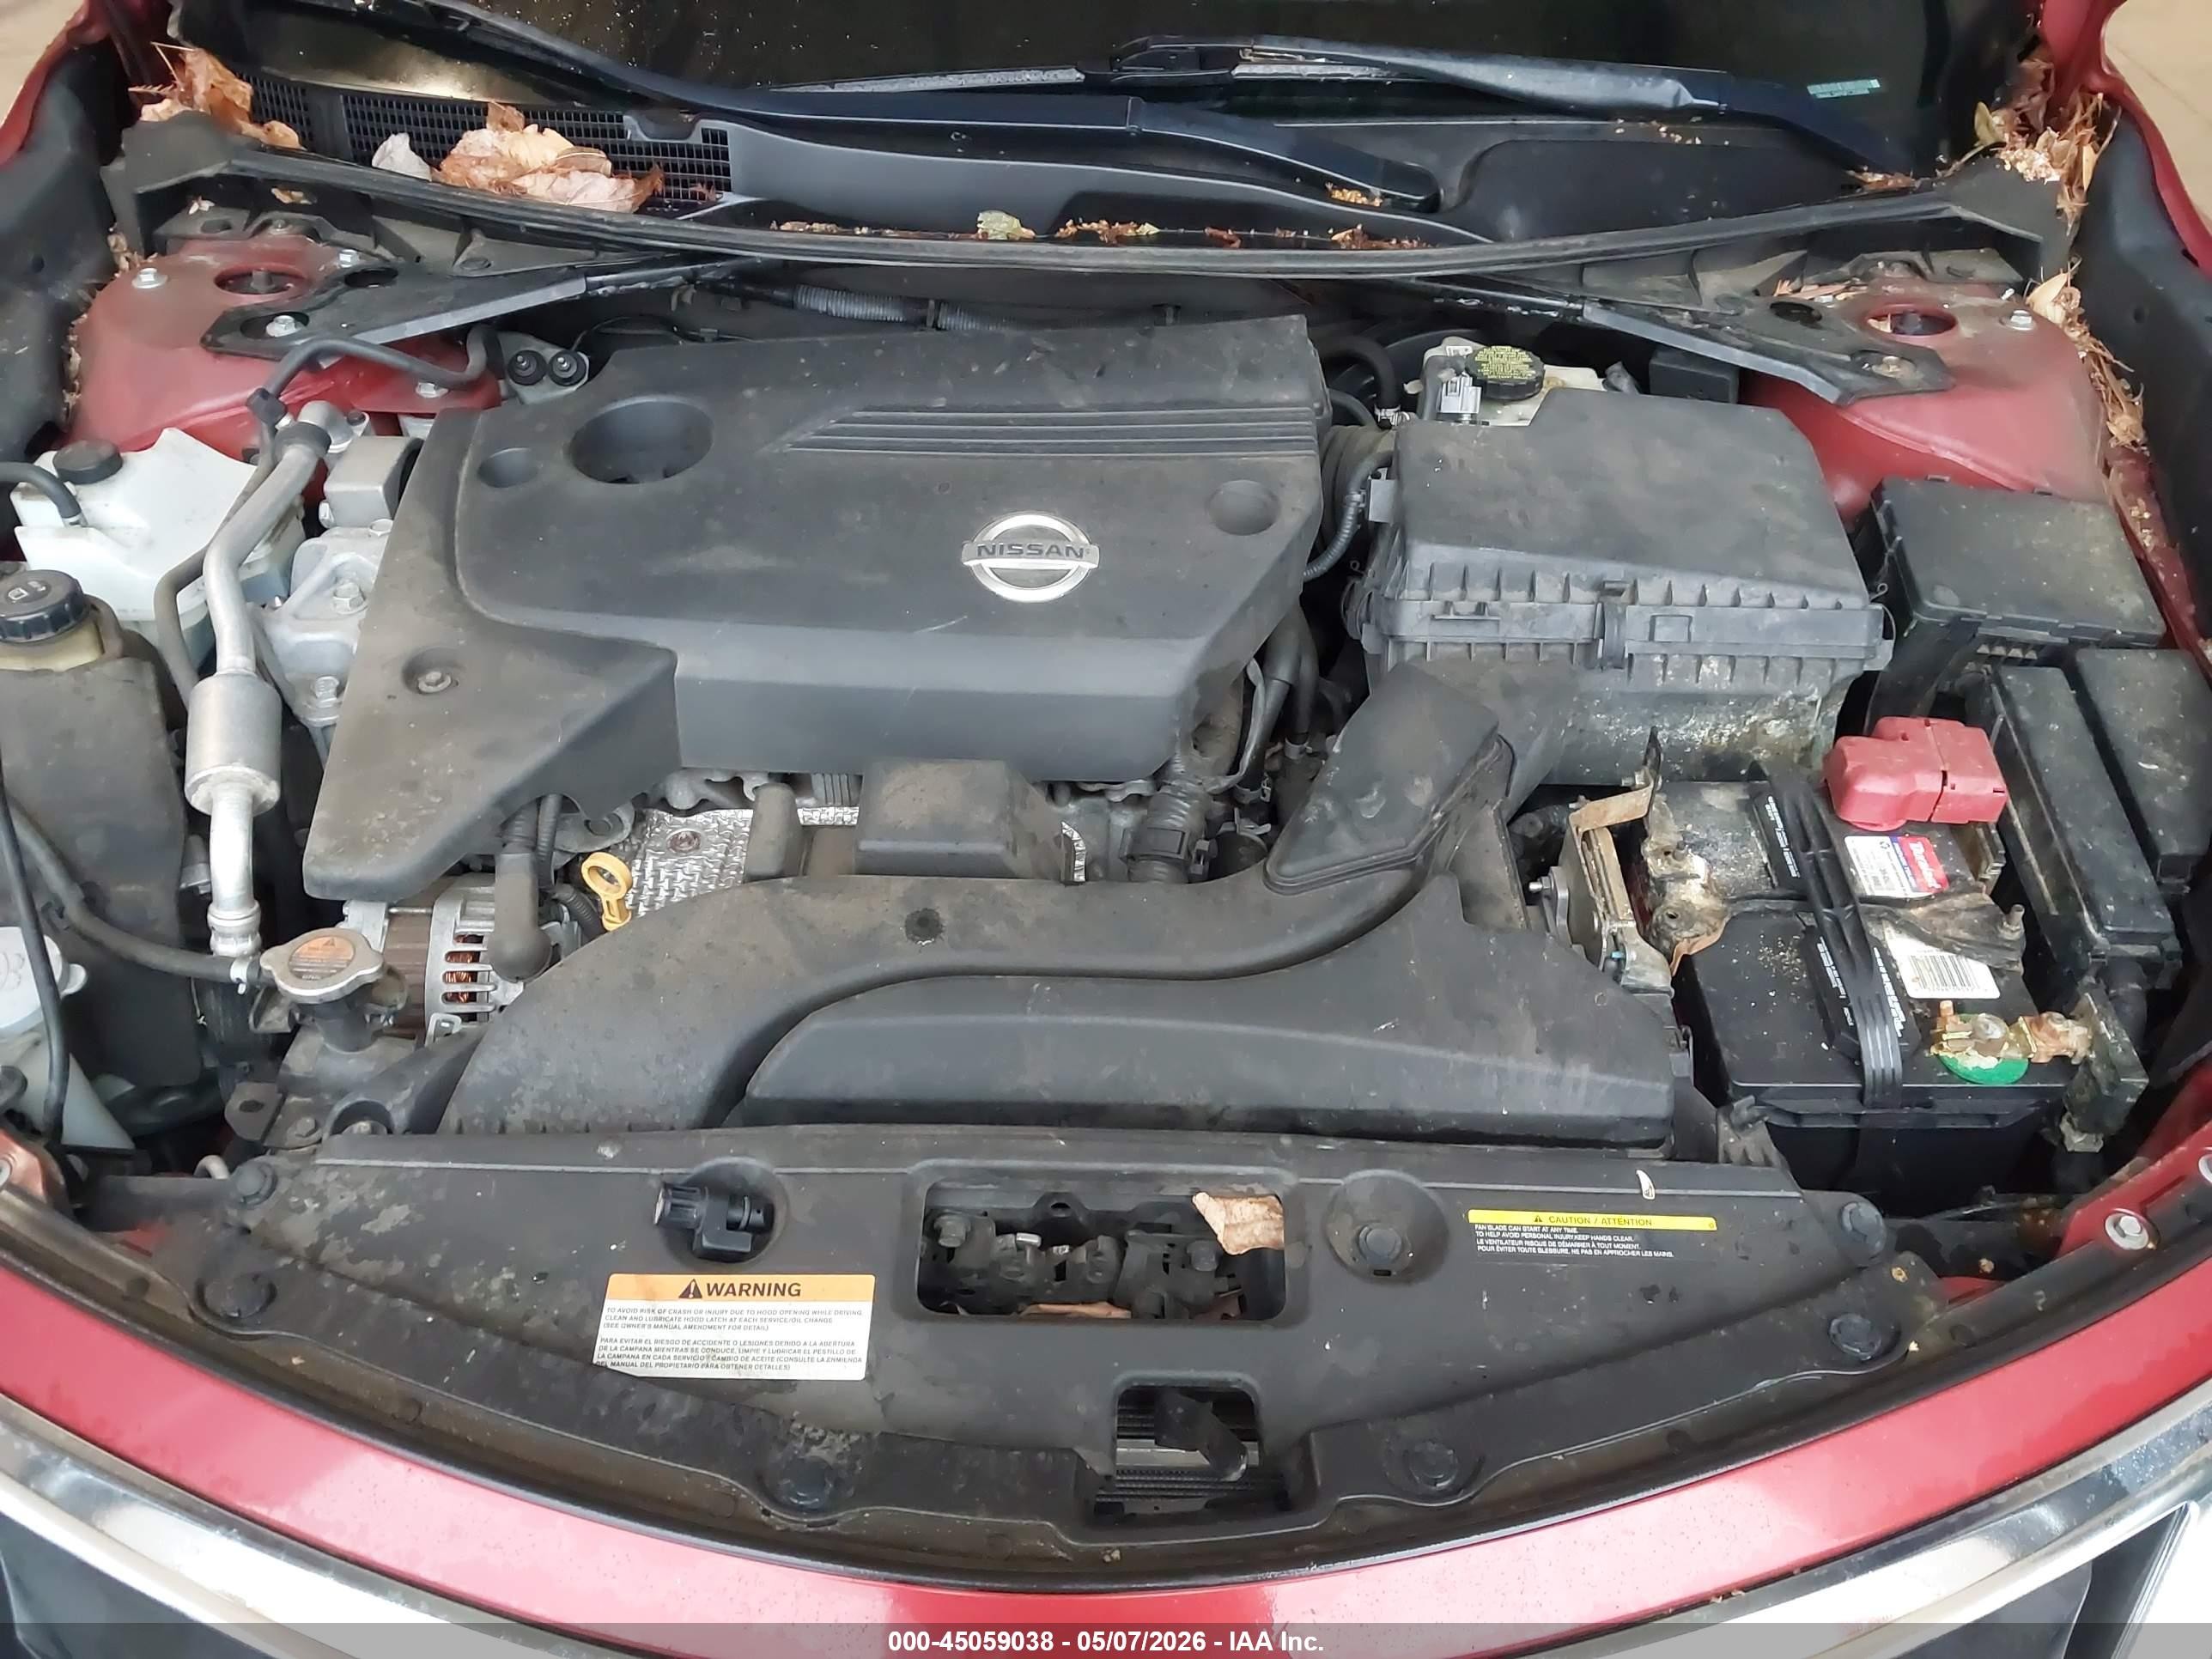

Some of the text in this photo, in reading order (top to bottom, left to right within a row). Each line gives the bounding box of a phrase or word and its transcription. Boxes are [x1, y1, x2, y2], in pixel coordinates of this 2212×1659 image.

[977, 544, 1084, 558] NISSAN
[1548, 1215, 1590, 1224] CAUTION
[1601, 1218, 1652, 1226] ATTENTION
[706, 1282, 802, 1297] WARNING
